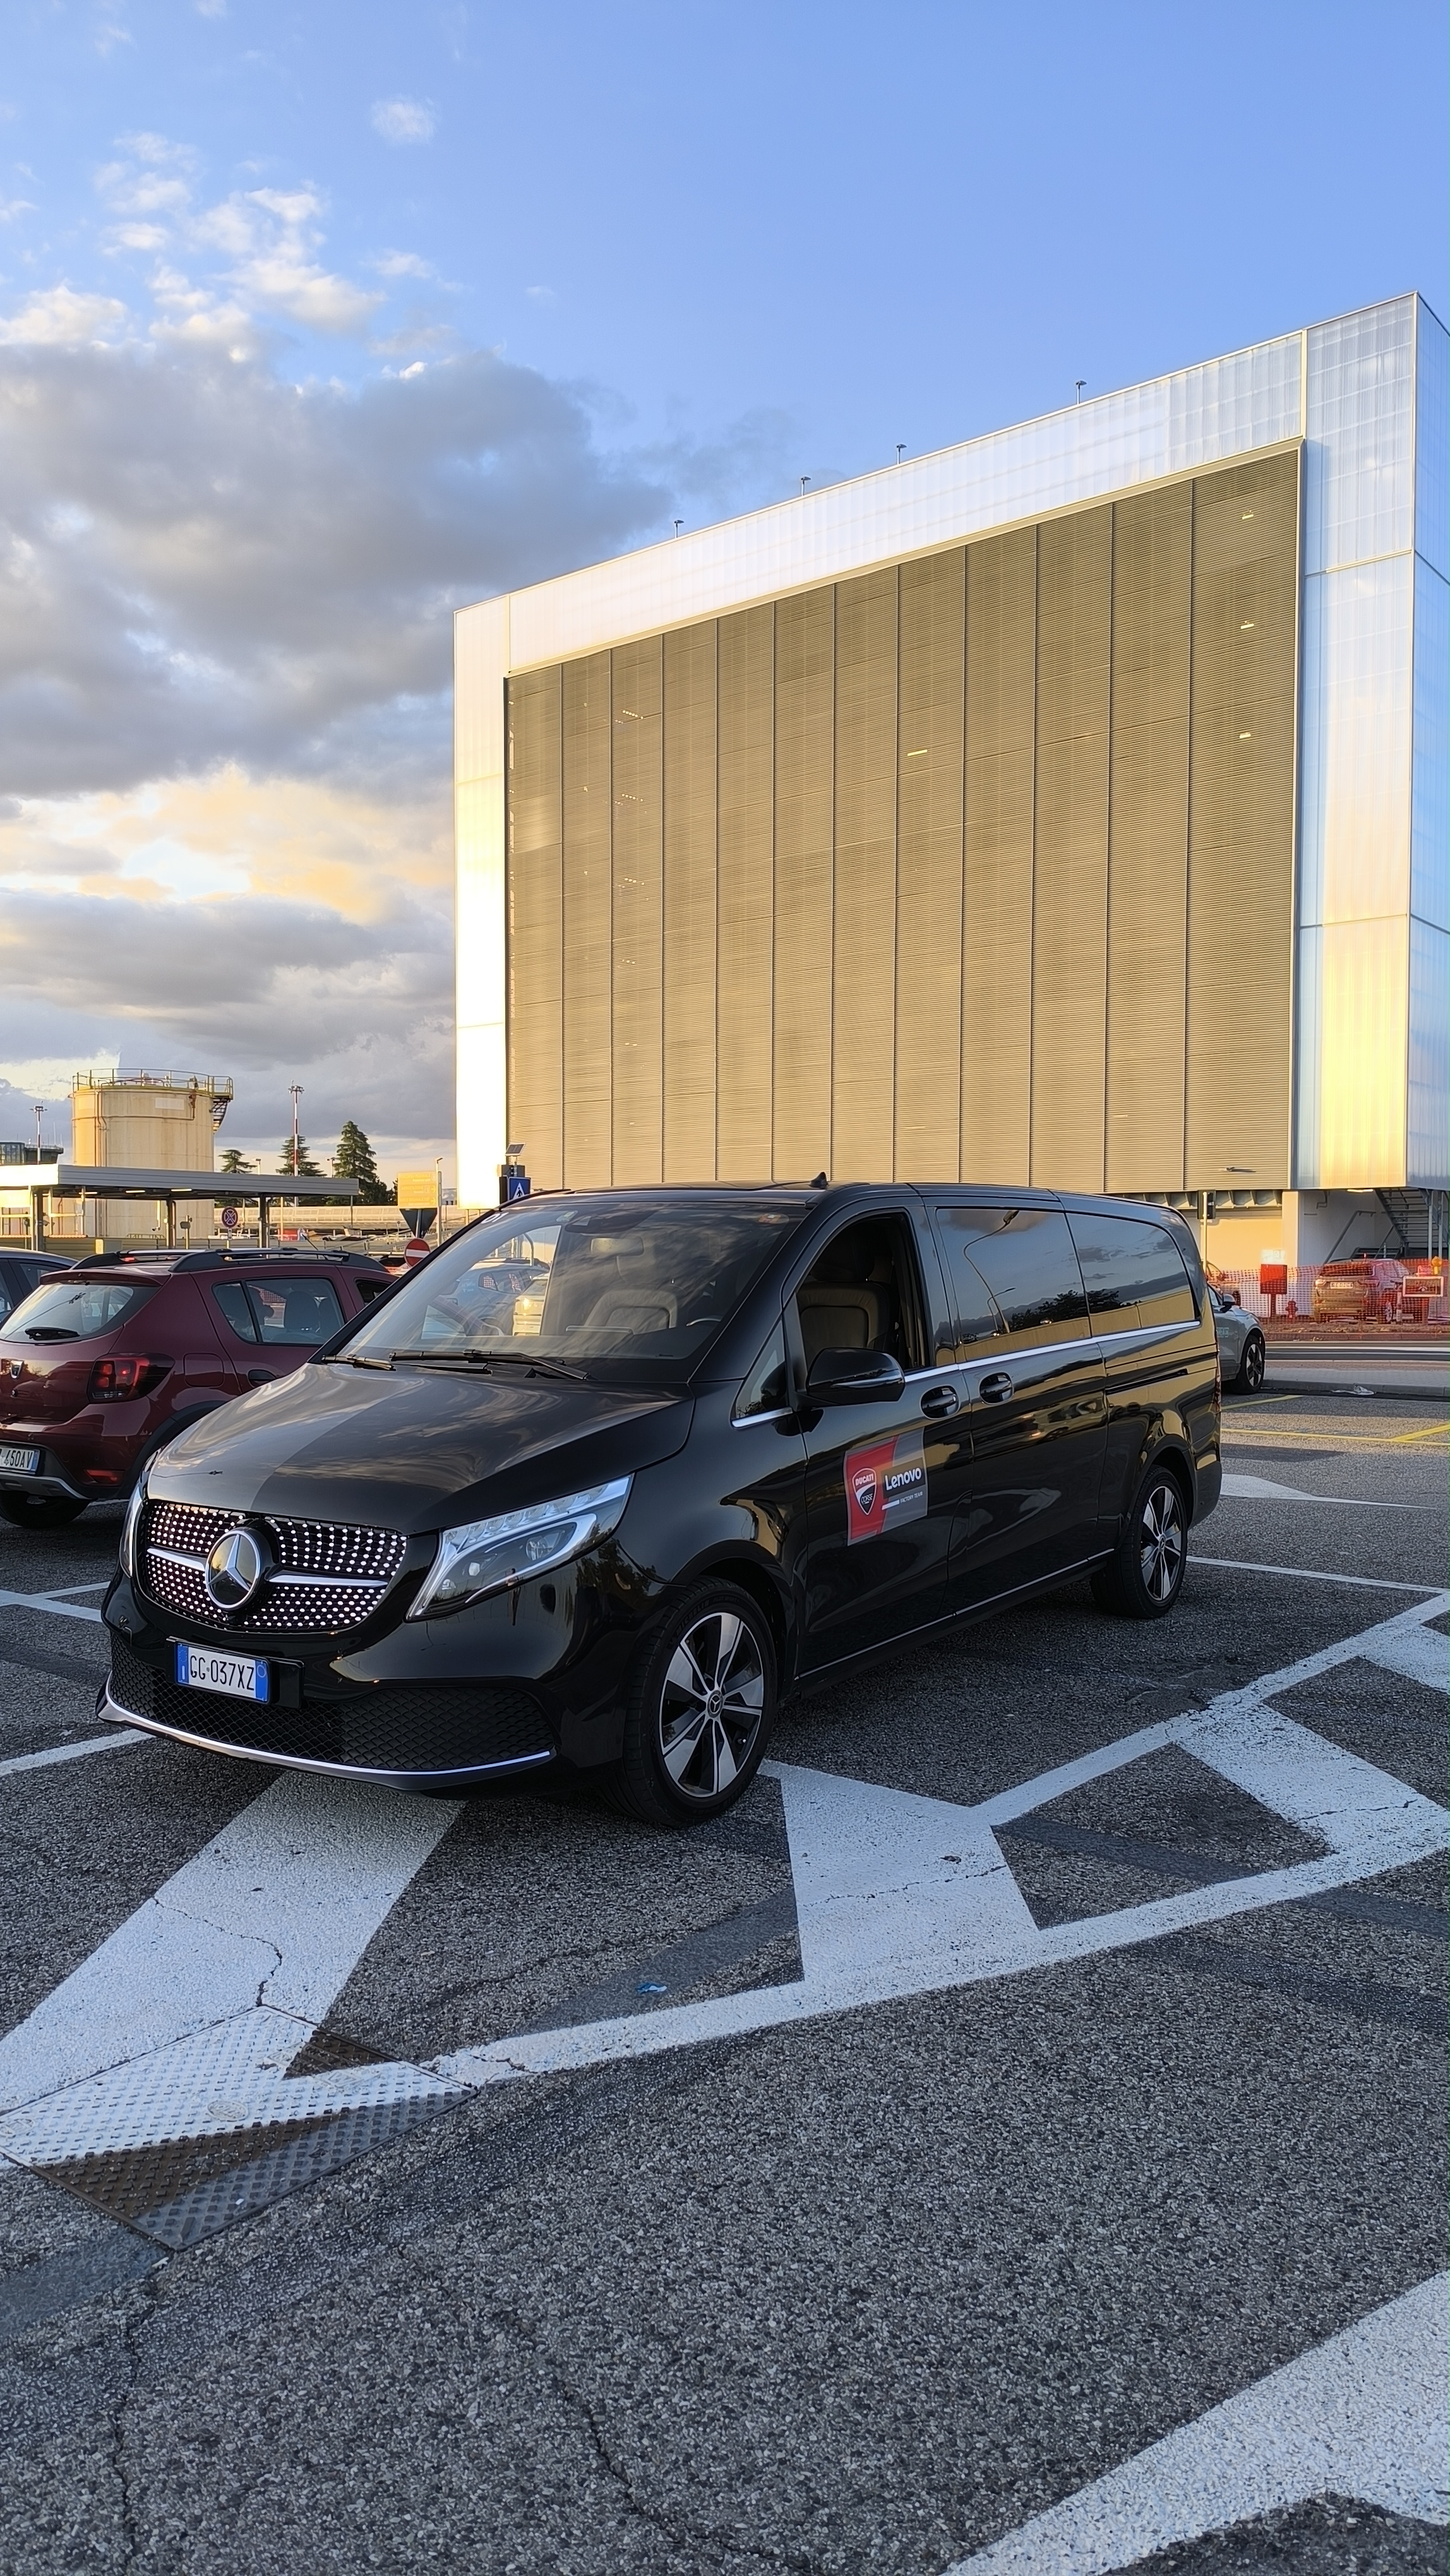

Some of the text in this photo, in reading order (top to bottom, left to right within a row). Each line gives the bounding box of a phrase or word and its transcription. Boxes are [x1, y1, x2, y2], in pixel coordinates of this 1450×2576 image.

[0, 1448, 33, 1469] 450AV
[855, 1473, 874, 1486] DUCATI
[885, 1467, 921, 1491] Lenovo
[861, 1493, 873, 1505] CORSE
[900, 1494, 913, 1504] FACTORY
